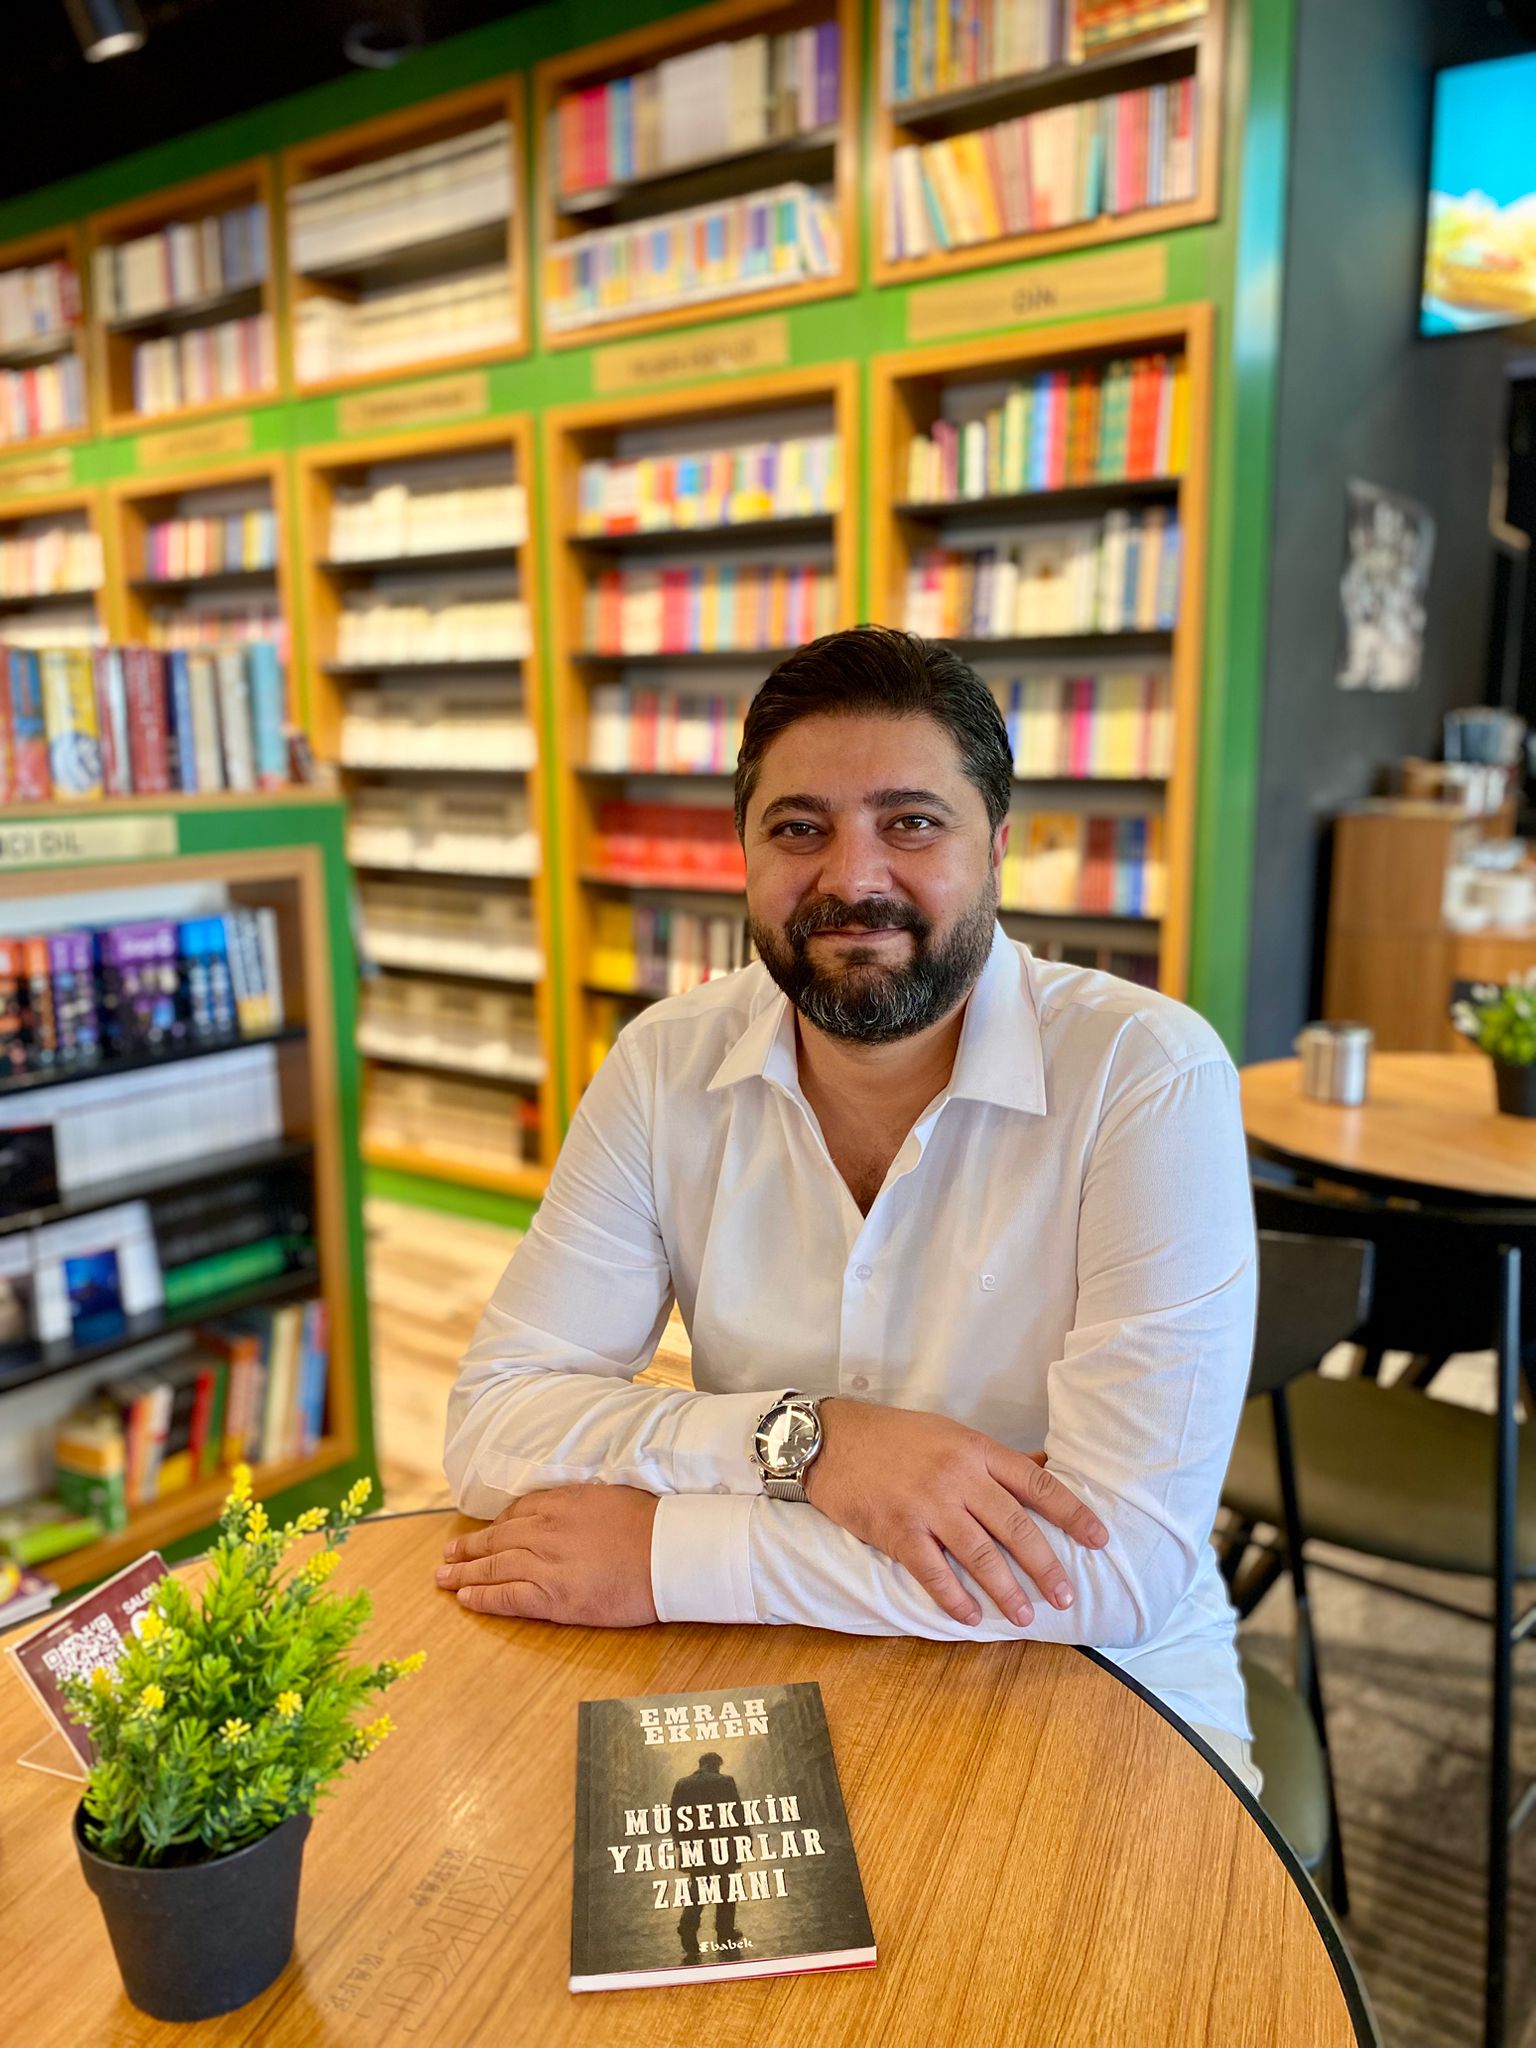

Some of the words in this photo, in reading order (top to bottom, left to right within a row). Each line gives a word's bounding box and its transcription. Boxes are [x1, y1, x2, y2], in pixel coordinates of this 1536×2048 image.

[640, 1698, 768, 1727] EMRAH
[644, 1716, 769, 1745] EKMEN
[624, 1794, 801, 1837] MÜSEKKİN
[607, 1828, 826, 1874] YAĞMURLAR
[652, 1868, 789, 1910] ZAMANI
